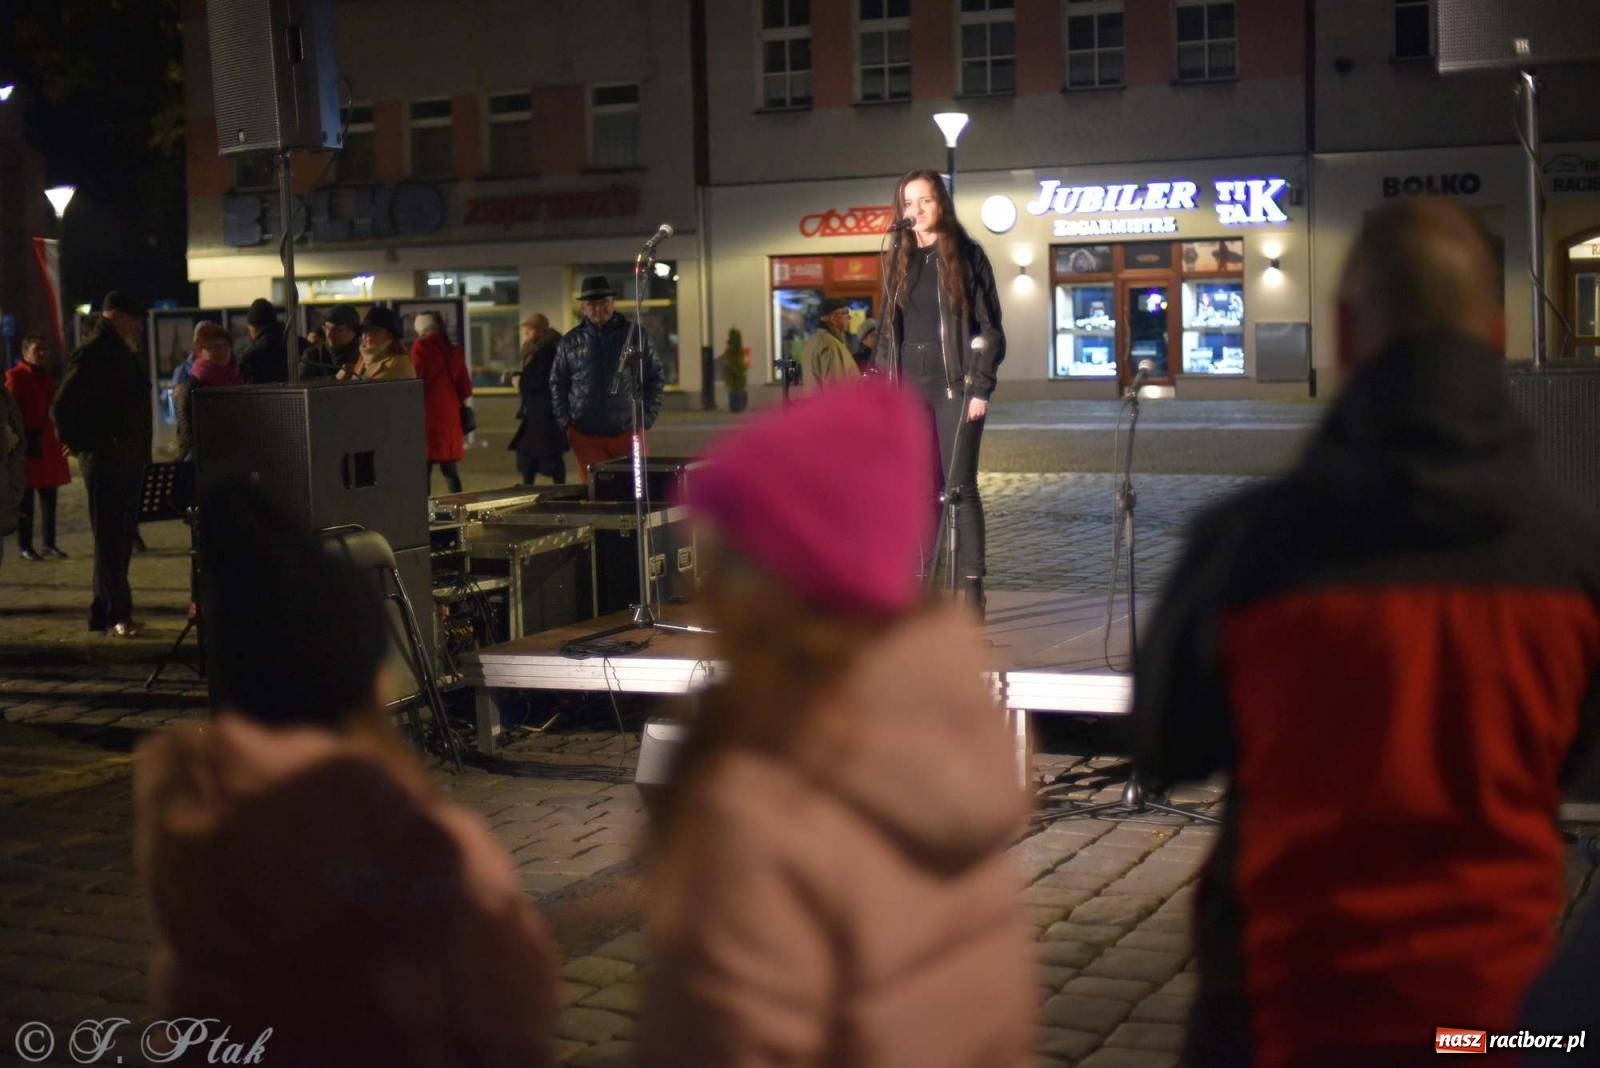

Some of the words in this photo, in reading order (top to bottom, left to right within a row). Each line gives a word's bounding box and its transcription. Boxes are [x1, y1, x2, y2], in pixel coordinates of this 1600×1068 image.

[1027, 180, 1198, 214] JUBILER
[1382, 173, 1481, 198] BOLKO
[223, 183, 443, 247] BOLKO
